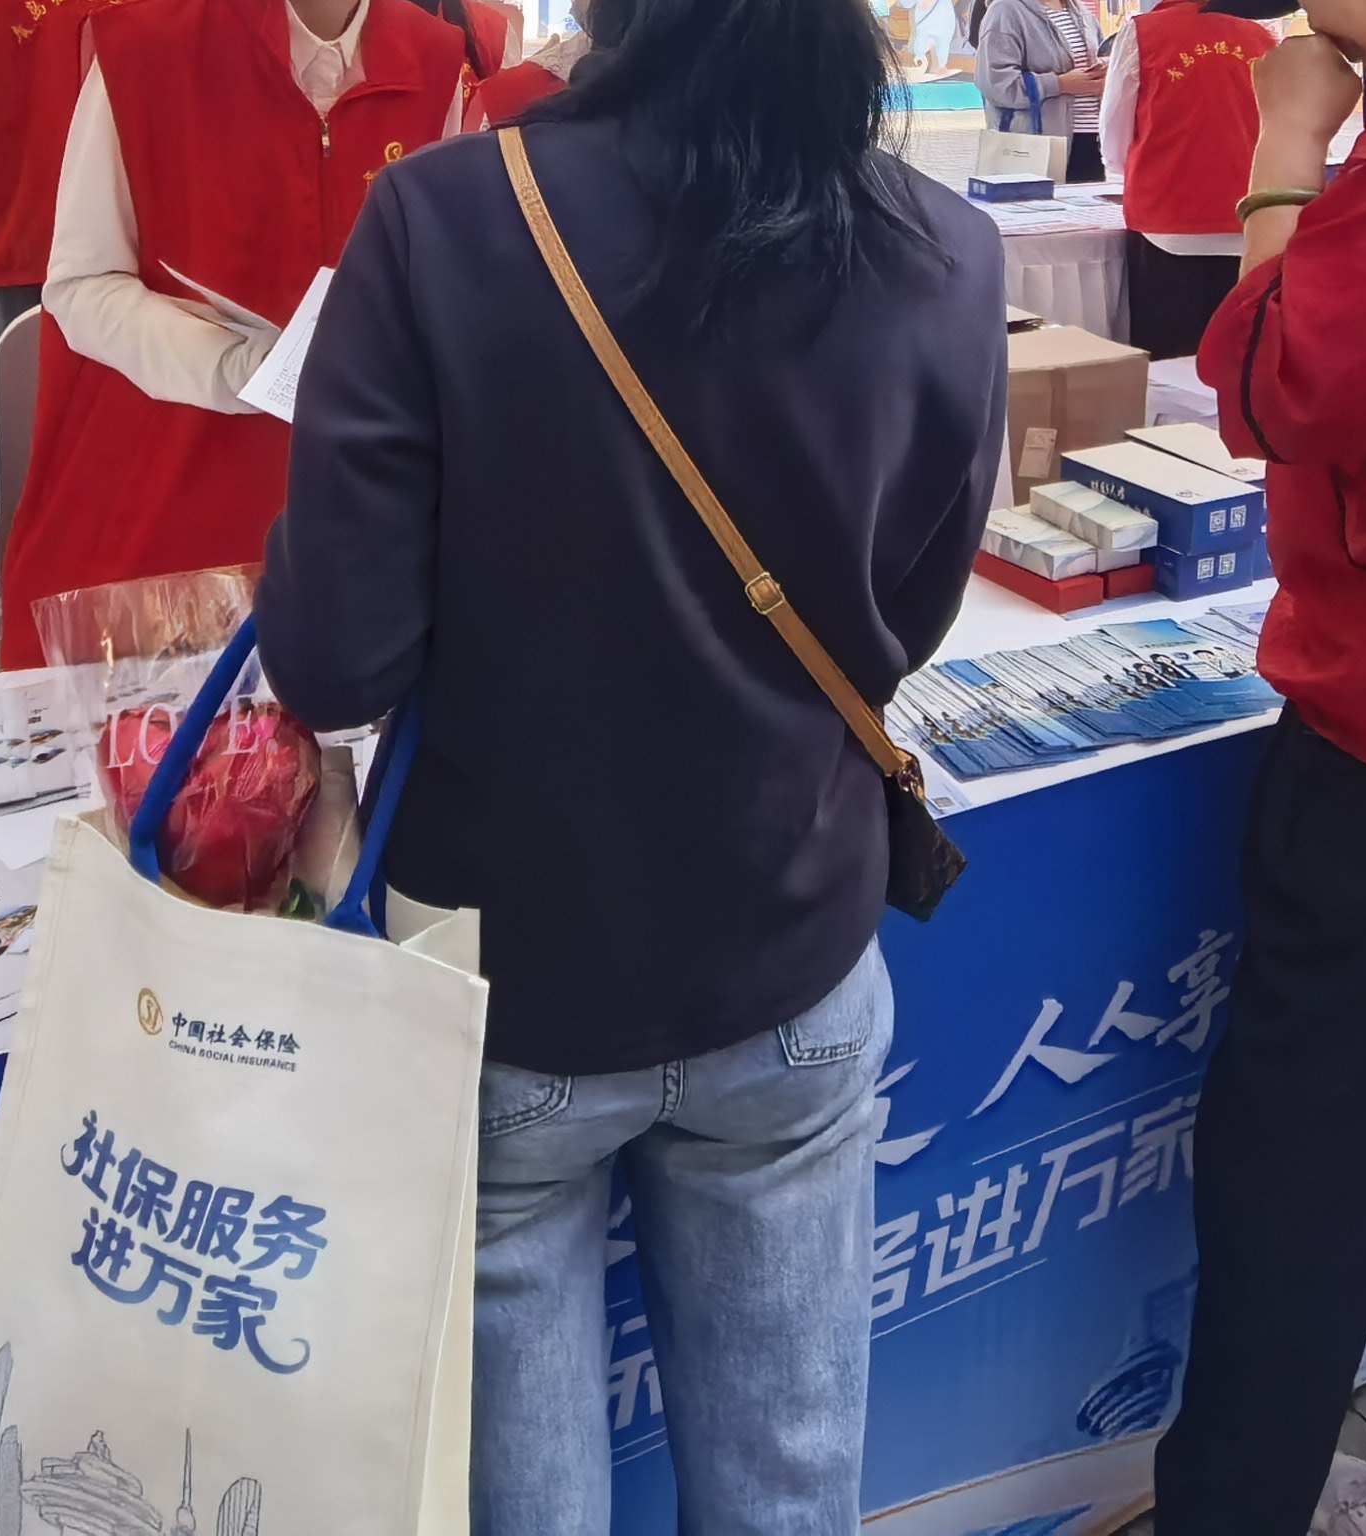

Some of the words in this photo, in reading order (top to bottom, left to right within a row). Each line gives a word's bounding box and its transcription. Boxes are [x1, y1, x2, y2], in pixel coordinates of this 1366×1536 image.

[107, 696, 264, 768] LOE
[168, 1039, 197, 1056] CHINA
[198, 1047, 235, 1064] SOCIAL
[236, 1055, 297, 1073] INSURANCE
[172, 1012, 301, 1055] 中国社会保险
[60, 1110, 330, 1280] 社保服务
[71, 1207, 311, 1375] 进万家
